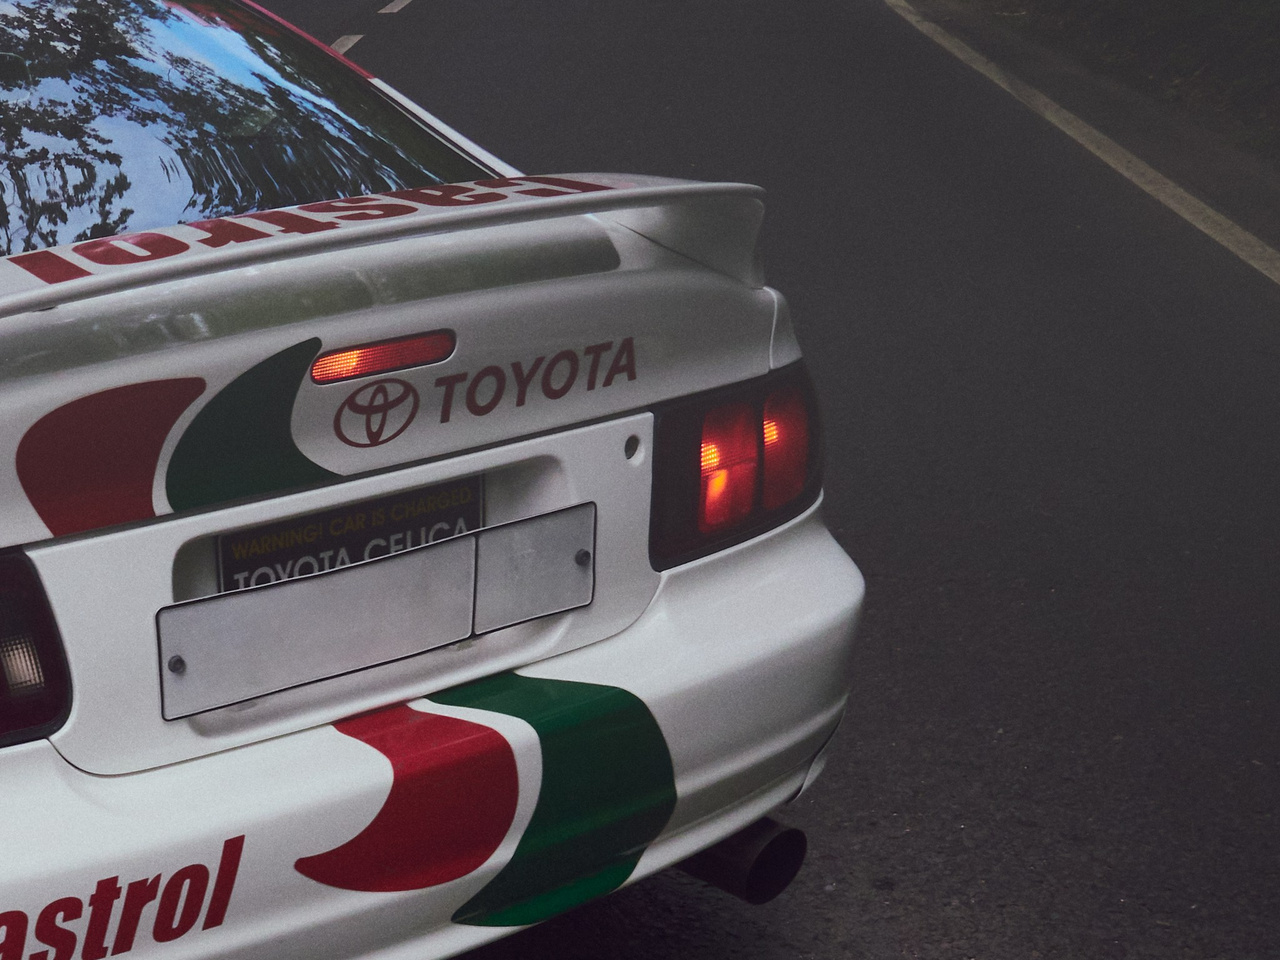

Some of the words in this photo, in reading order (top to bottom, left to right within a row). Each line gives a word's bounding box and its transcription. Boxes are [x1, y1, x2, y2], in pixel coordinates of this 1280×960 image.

[435, 337, 637, 424] TOYOTA
[232, 526, 323, 560] WARNING!
[329, 513, 366, 536] CAR
[371, 508, 386, 526] IS
[391, 486, 472, 521] CHARGED
[233, 547, 351, 590] TOYOTA
